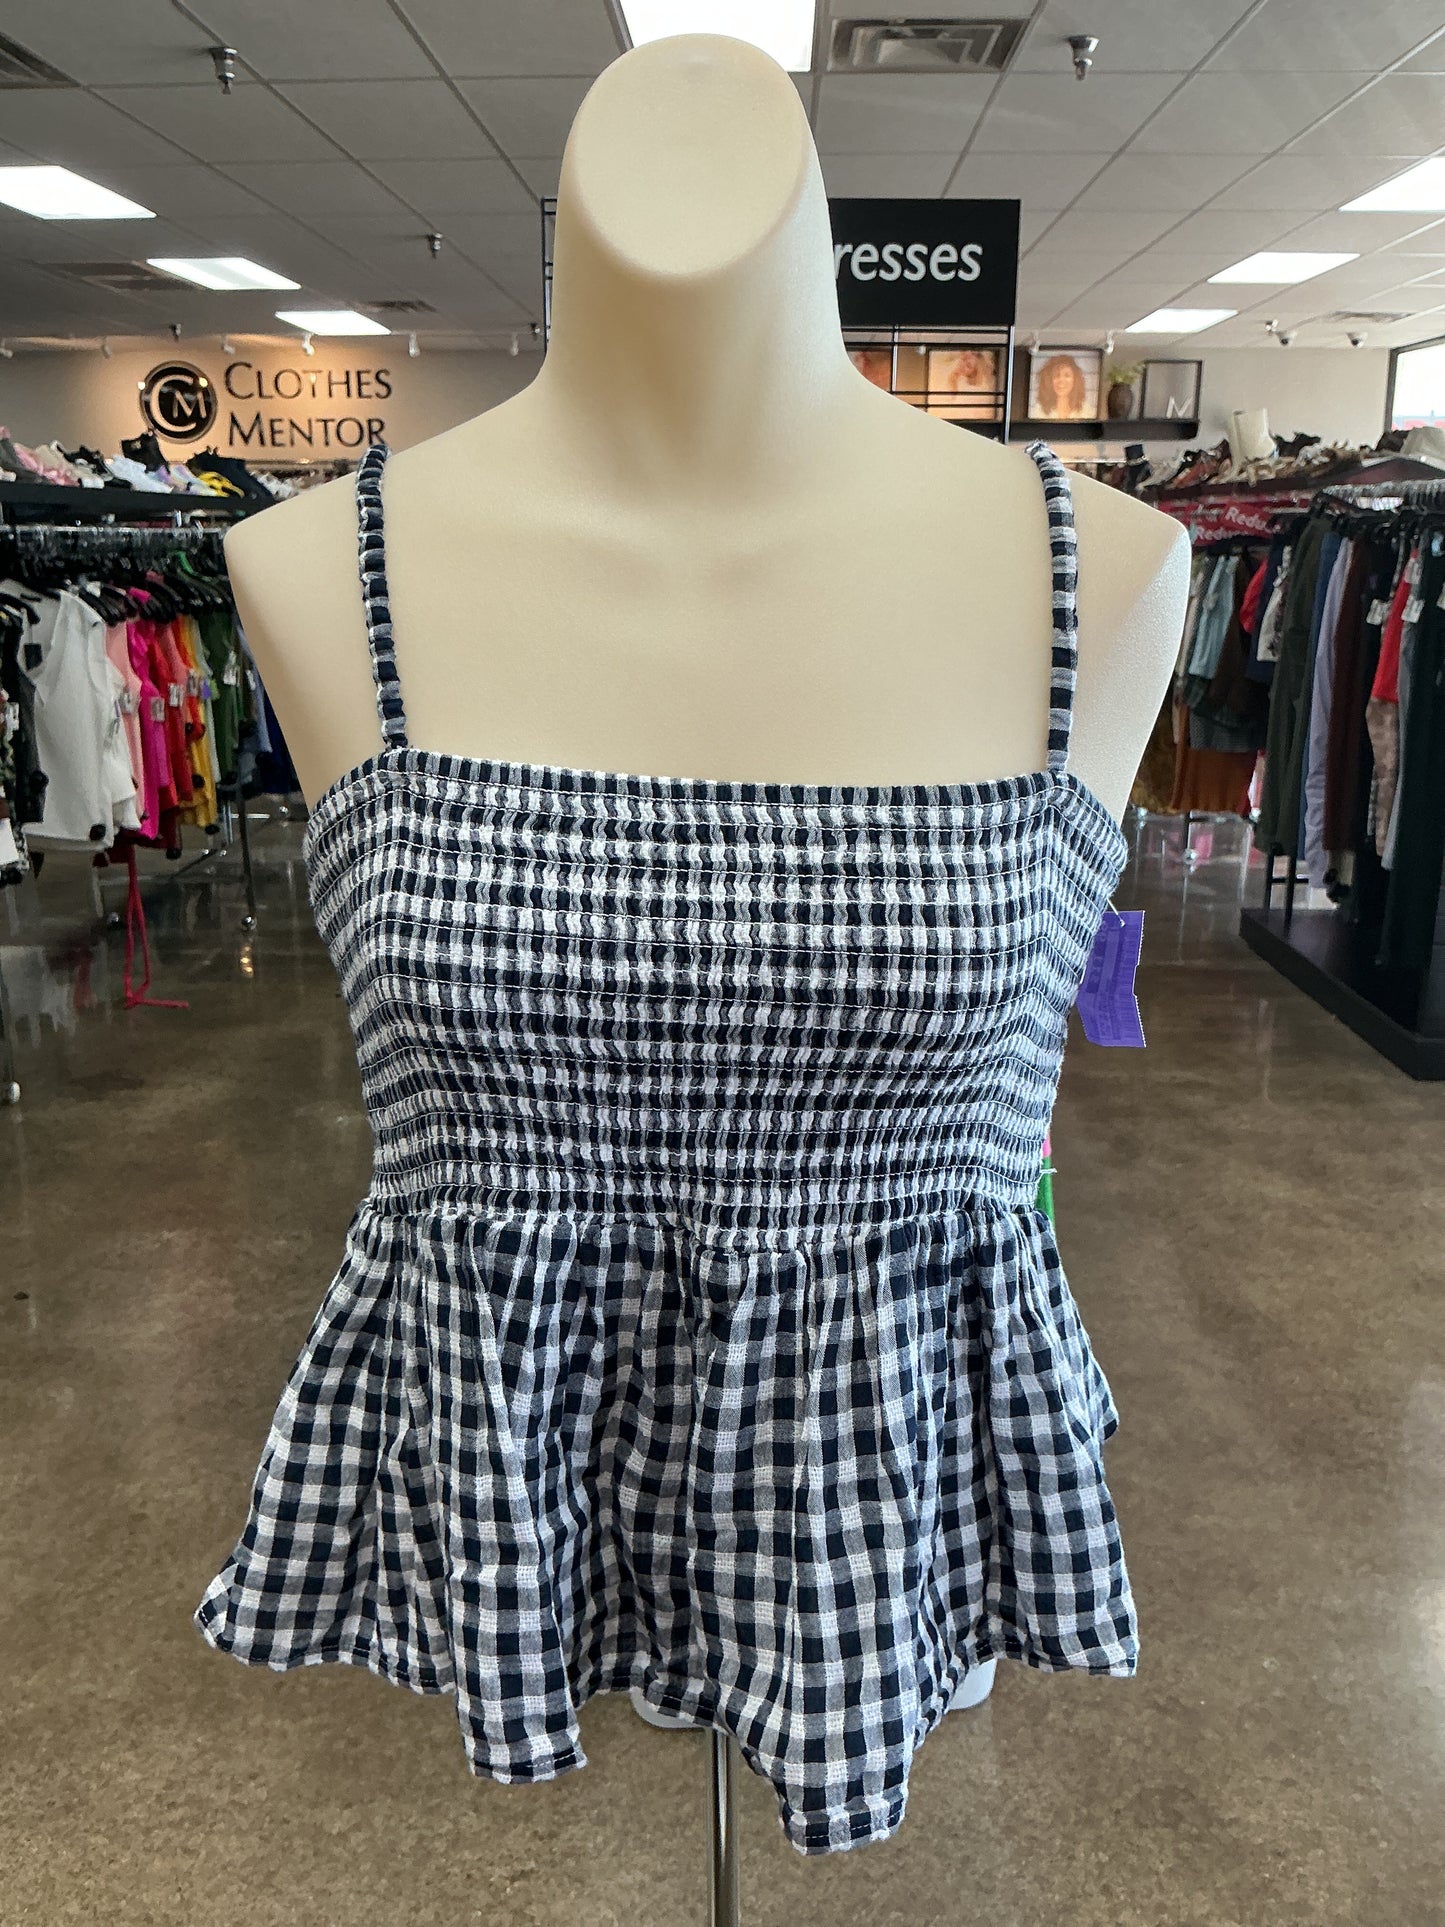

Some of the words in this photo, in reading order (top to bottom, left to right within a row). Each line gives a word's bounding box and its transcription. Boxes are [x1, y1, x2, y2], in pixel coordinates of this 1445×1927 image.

[834, 243, 983, 281] resses
[224, 362, 392, 399] CLOTHES
[229, 411, 386, 447] MENTOR
